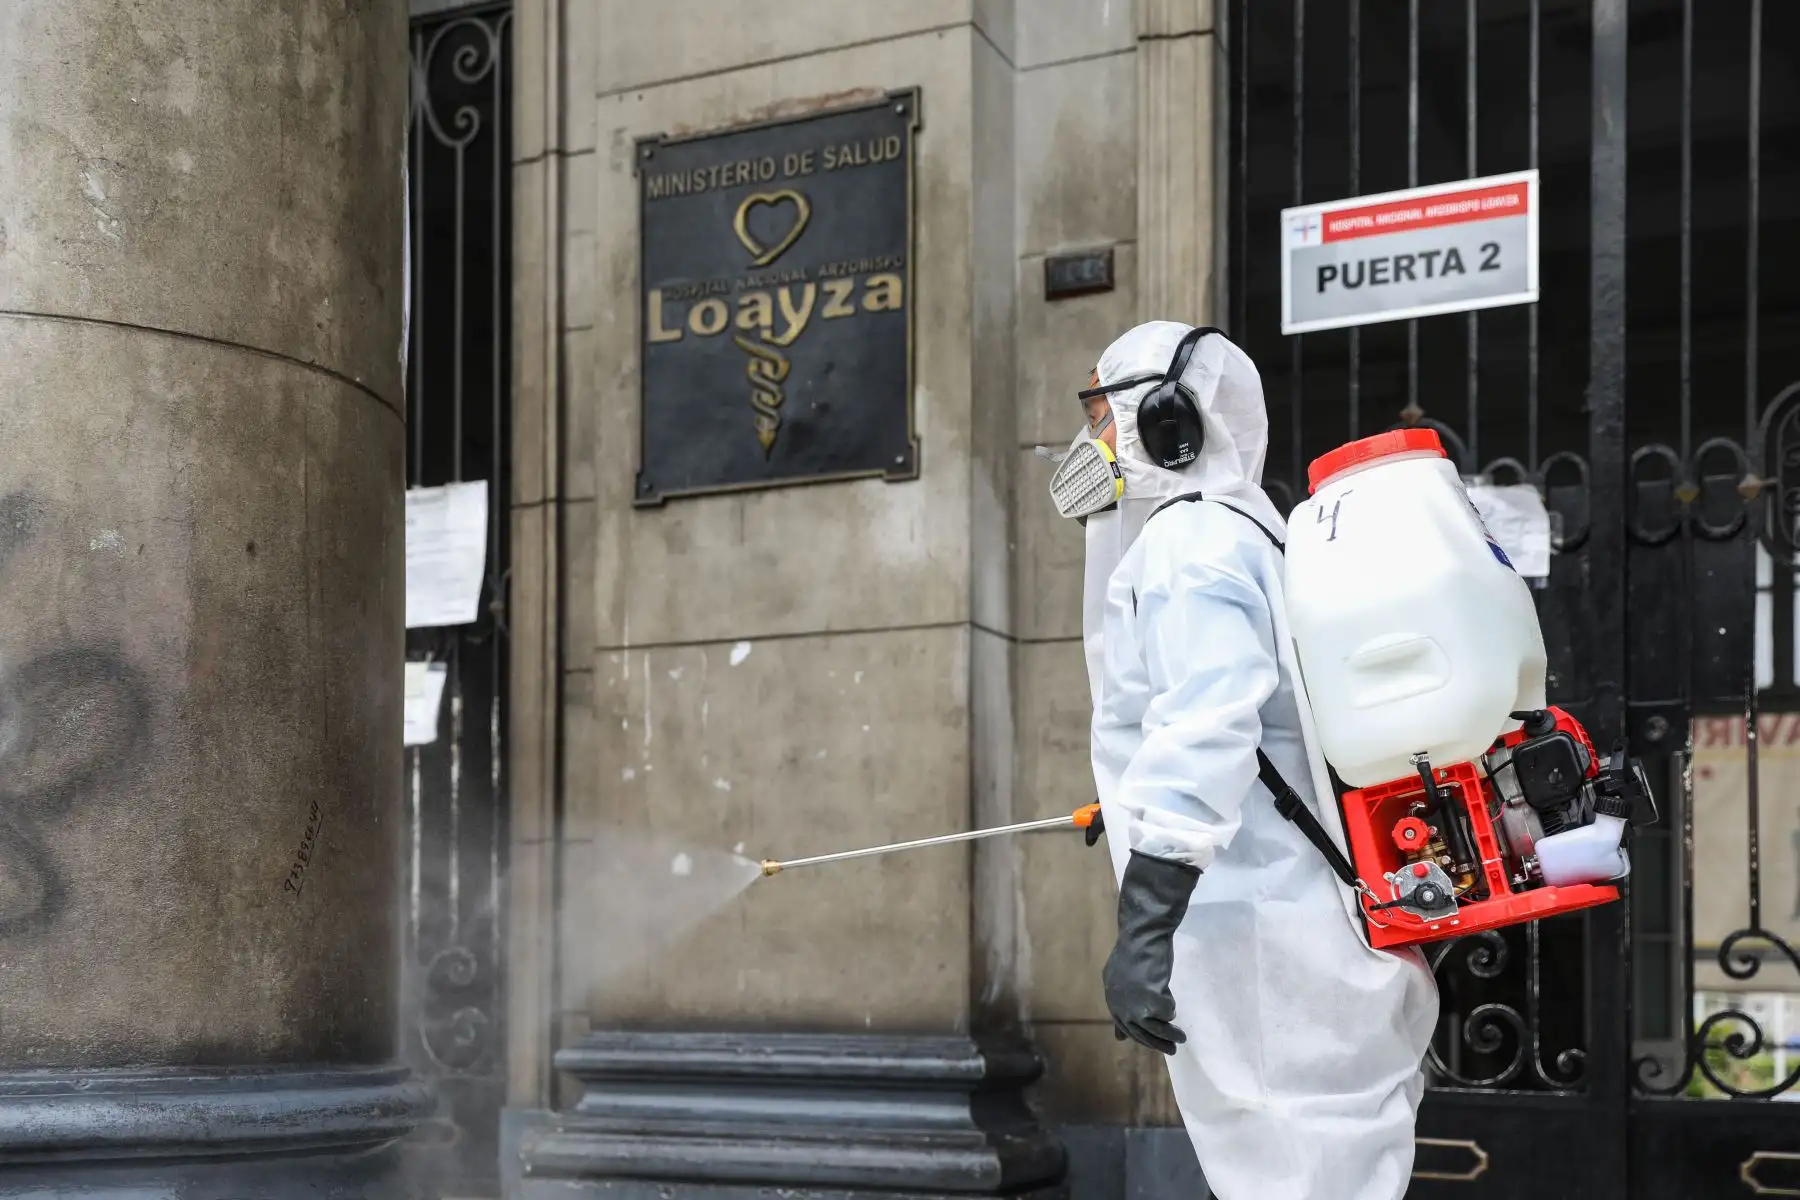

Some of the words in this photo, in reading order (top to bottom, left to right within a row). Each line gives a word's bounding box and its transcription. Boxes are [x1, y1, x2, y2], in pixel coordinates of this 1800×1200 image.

[646, 156, 776, 199] MINISTERIO
[783, 149, 815, 178] DE
[822, 135, 902, 170] SALUD
[818, 254, 904, 277] ARZOBISPO
[1317, 246, 1466, 294] PUERTA
[1478, 241, 1502, 273] 2
[647, 272, 903, 346] Loayza
